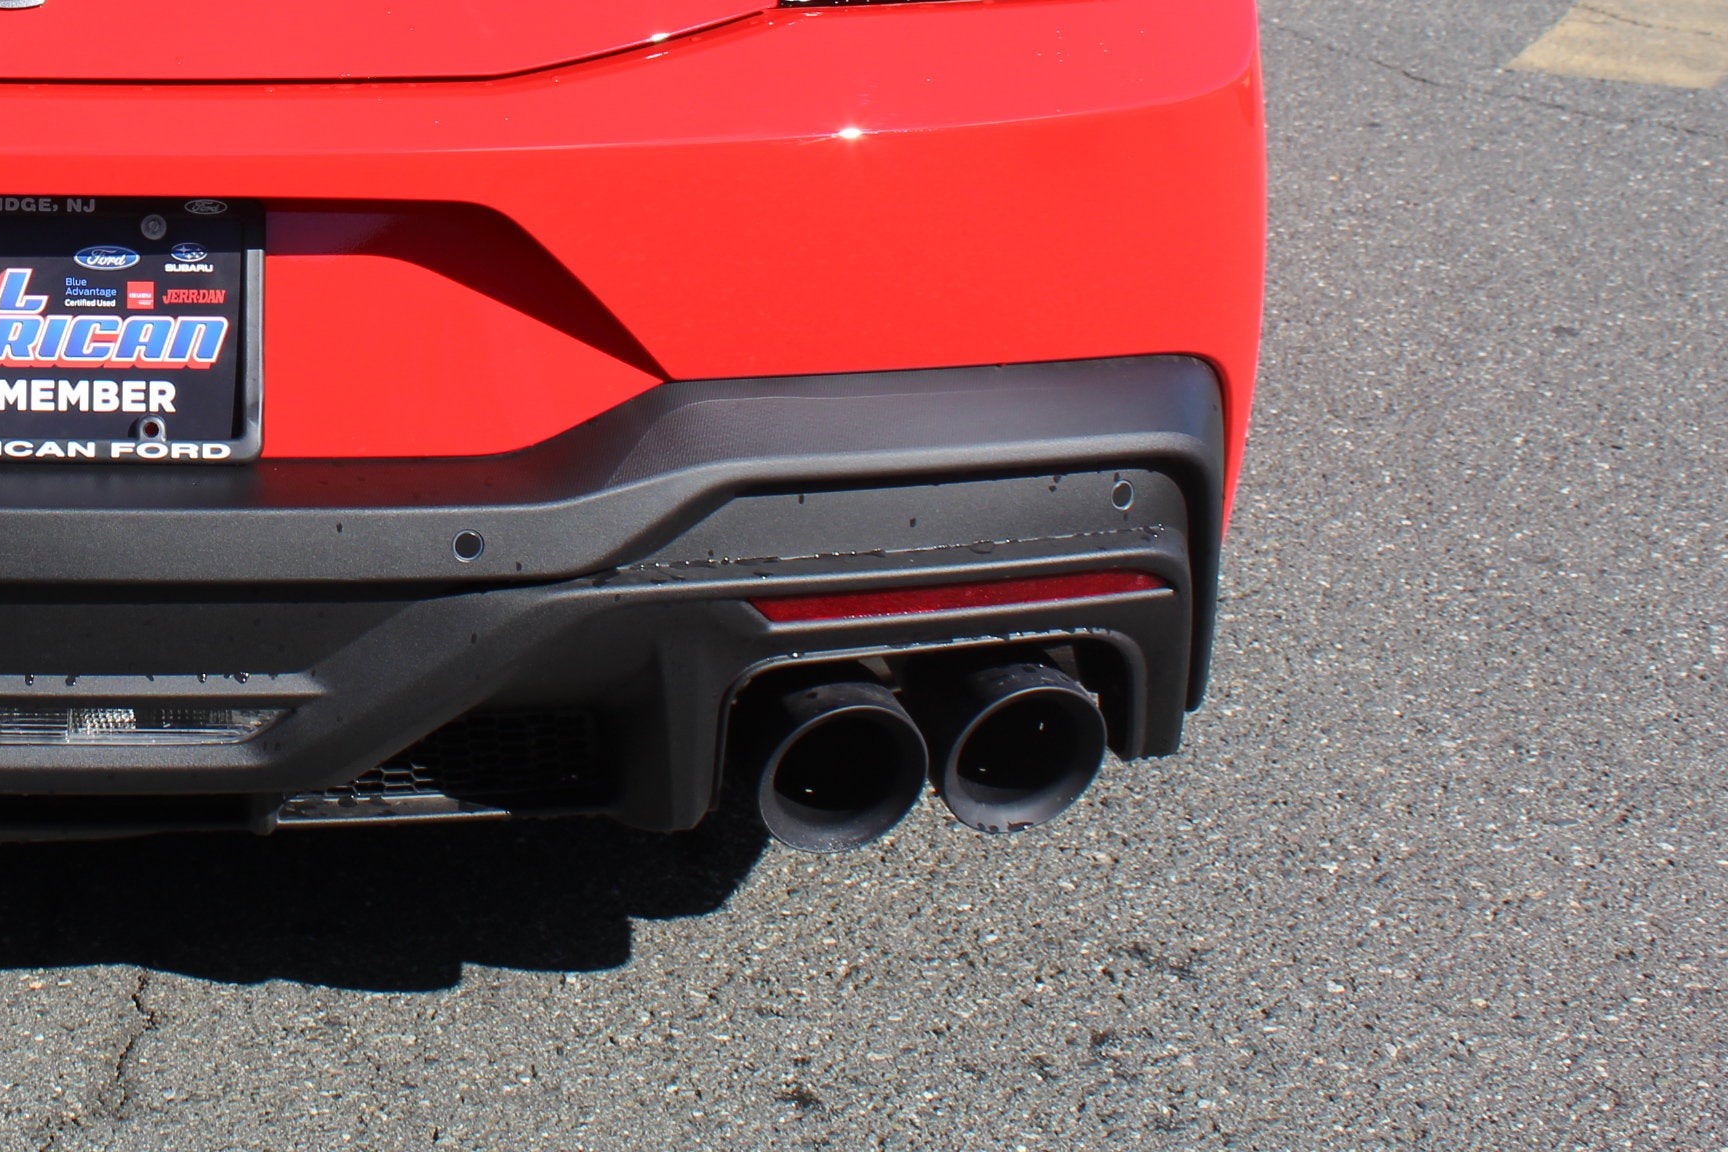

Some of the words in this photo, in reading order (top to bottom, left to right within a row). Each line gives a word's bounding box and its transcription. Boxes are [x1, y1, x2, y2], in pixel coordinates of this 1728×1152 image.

[66, 198, 97, 213] NJ
[164, 263, 214, 273] SUBARU
[65, 277, 88, 287] Blue
[65, 287, 117, 298] Advantage
[64, 298, 96, 308] Certified
[97, 299, 116, 308] Used
[110, 441, 232, 459] FORD
